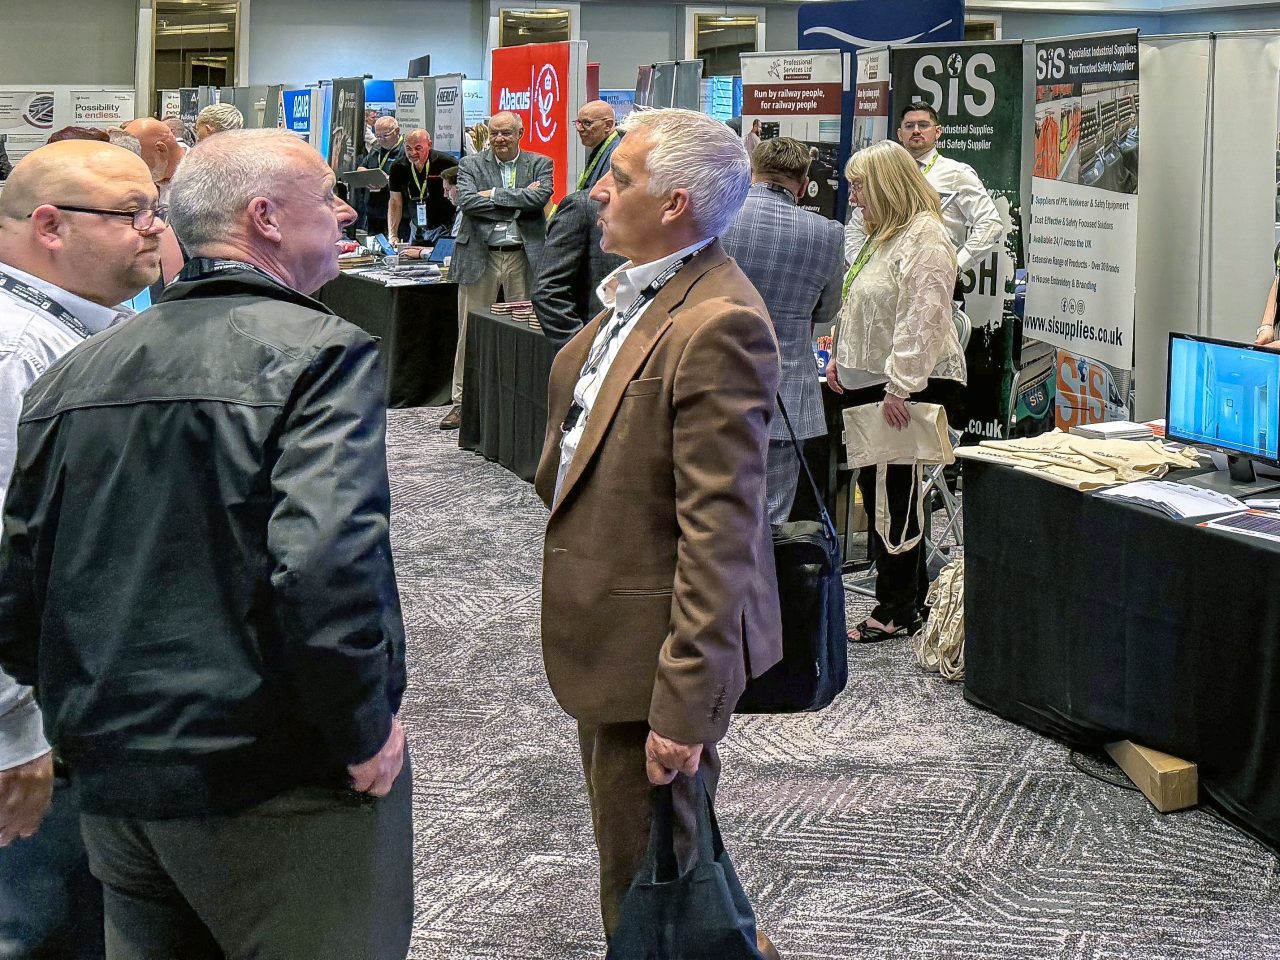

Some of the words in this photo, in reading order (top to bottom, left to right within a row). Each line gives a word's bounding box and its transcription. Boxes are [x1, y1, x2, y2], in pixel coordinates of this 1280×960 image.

[783, 57, 813, 66] Professional
[1036, 47, 1066, 80] SiS
[1068, 46, 1092, 60] Specialist
[1091, 44, 1114, 57] Industrial
[1114, 43, 1137, 56] Supplies
[1069, 64, 1079, 75] Your
[1079, 62, 1098, 74] Trusted
[1097, 61, 1112, 75] Safety
[1112, 59, 1136, 73] Supplier
[783, 66, 803, 74] Services
[803, 65, 812, 73] Ltd
[911, 52, 996, 117] SiS
[499, 87, 530, 110] Abacus
[754, 89, 767, 98] Run
[768, 89, 777, 100] by
[778, 88, 801, 100] railway
[801, 88, 825, 100] people,
[75, 103, 120, 112] Possibility
[760, 101, 771, 110] for
[771, 100, 796, 112] railway
[796, 99, 818, 111] people
[75, 111, 83, 119] is
[85, 111, 121, 119] endless.
[969, 124, 994, 137] Supplies
[946, 139, 967, 151] Safety
[967, 139, 992, 151] Supplier
[1024, 315, 1123, 346] www.sisupplies.co.uk
[1055, 350, 1105, 433] SiS
[1029, 391, 1044, 406] SiS
